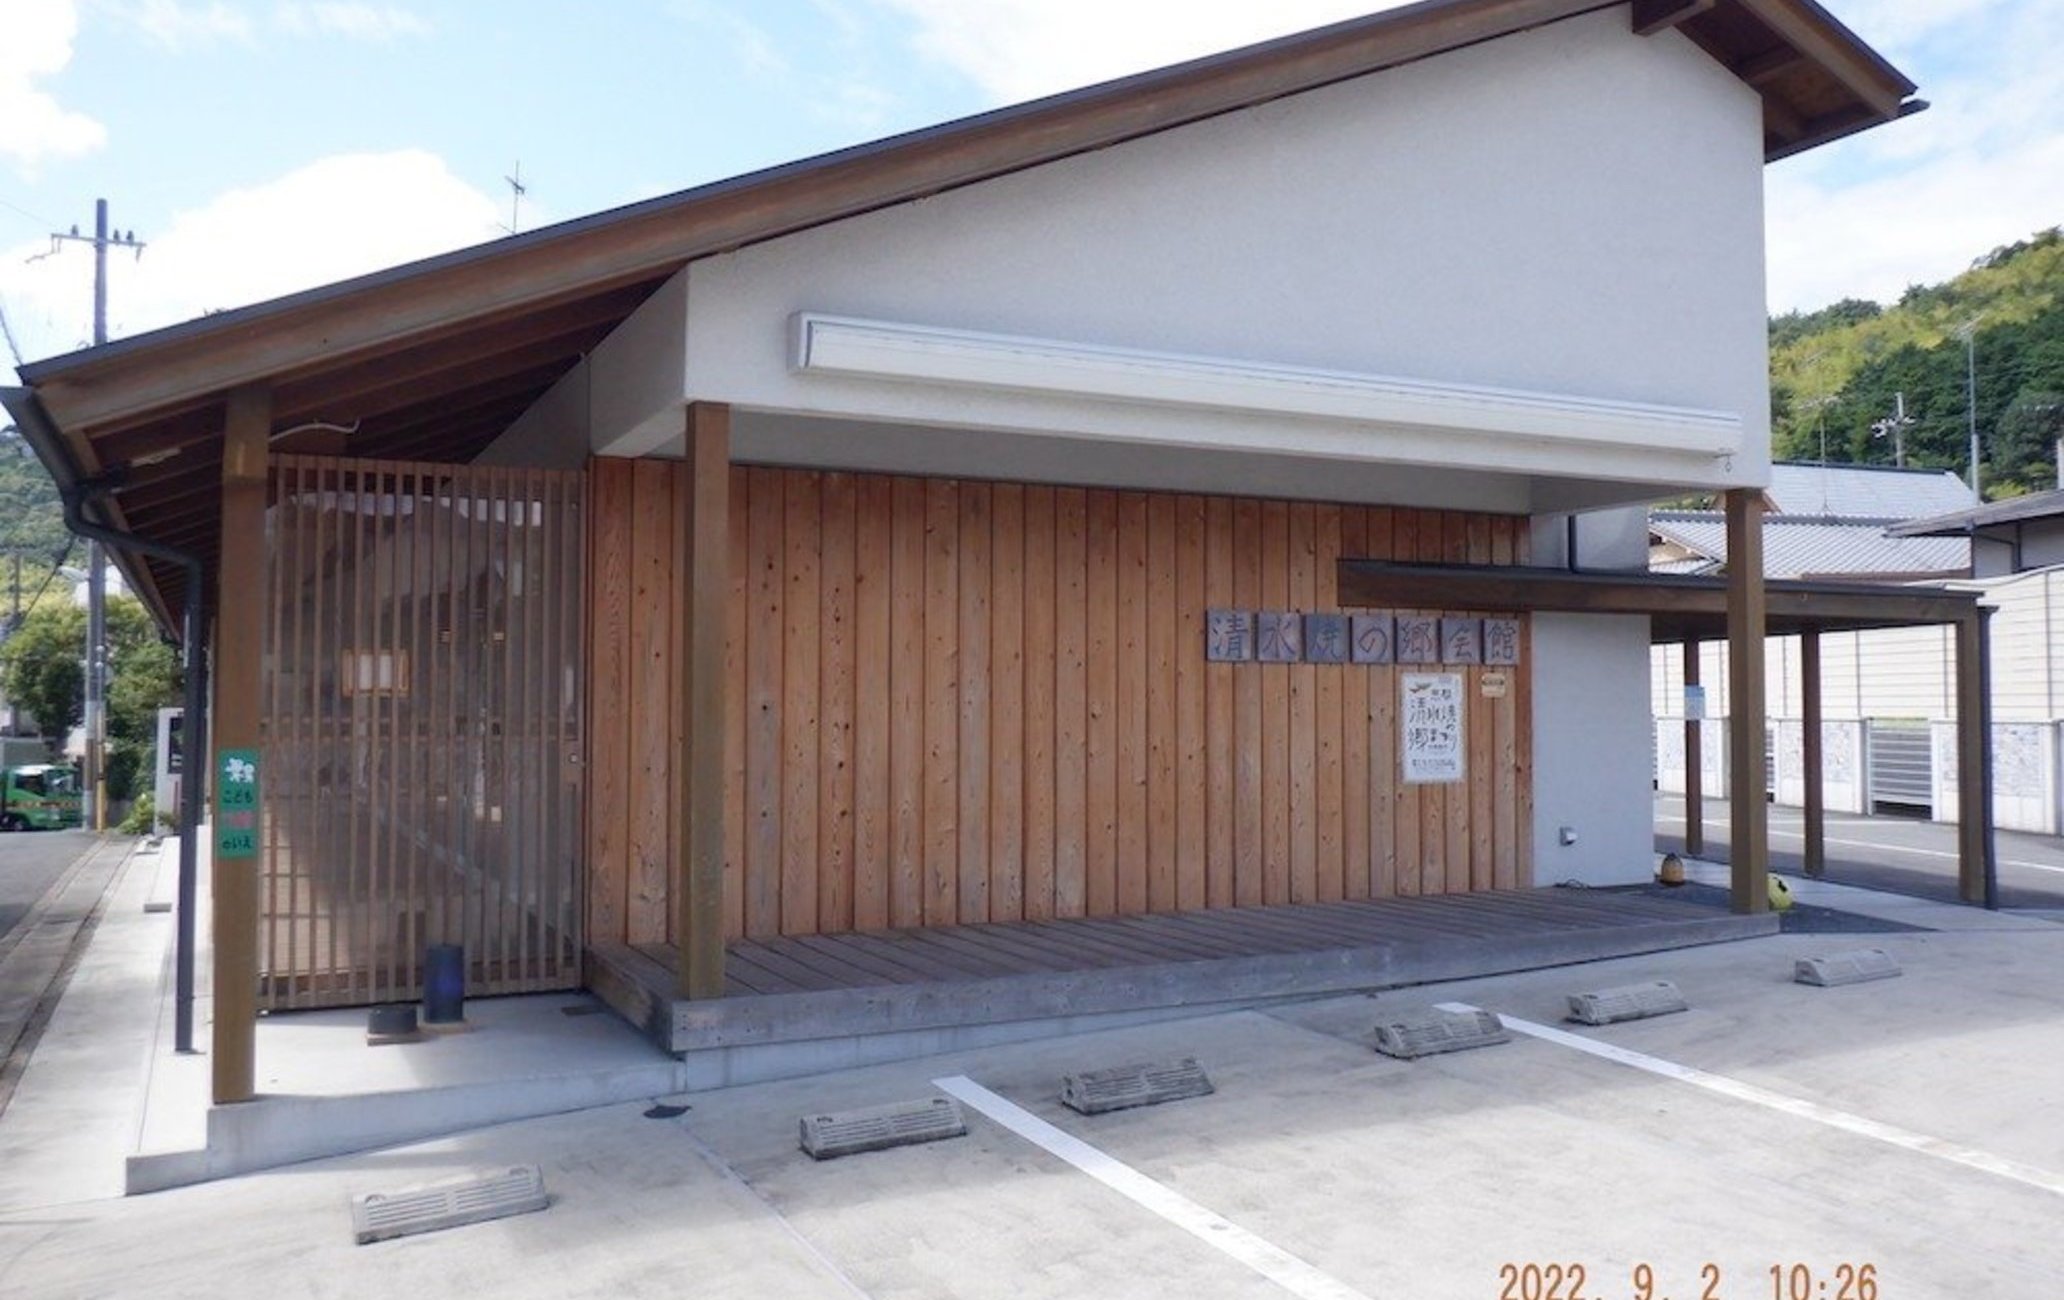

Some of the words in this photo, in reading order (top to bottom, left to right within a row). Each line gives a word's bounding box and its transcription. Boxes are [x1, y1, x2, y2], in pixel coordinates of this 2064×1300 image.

[1213, 614, 1517, 661] 清水焼の郷会館
[222, 789, 253, 803] こども
[222, 835, 252, 849] のいえ
